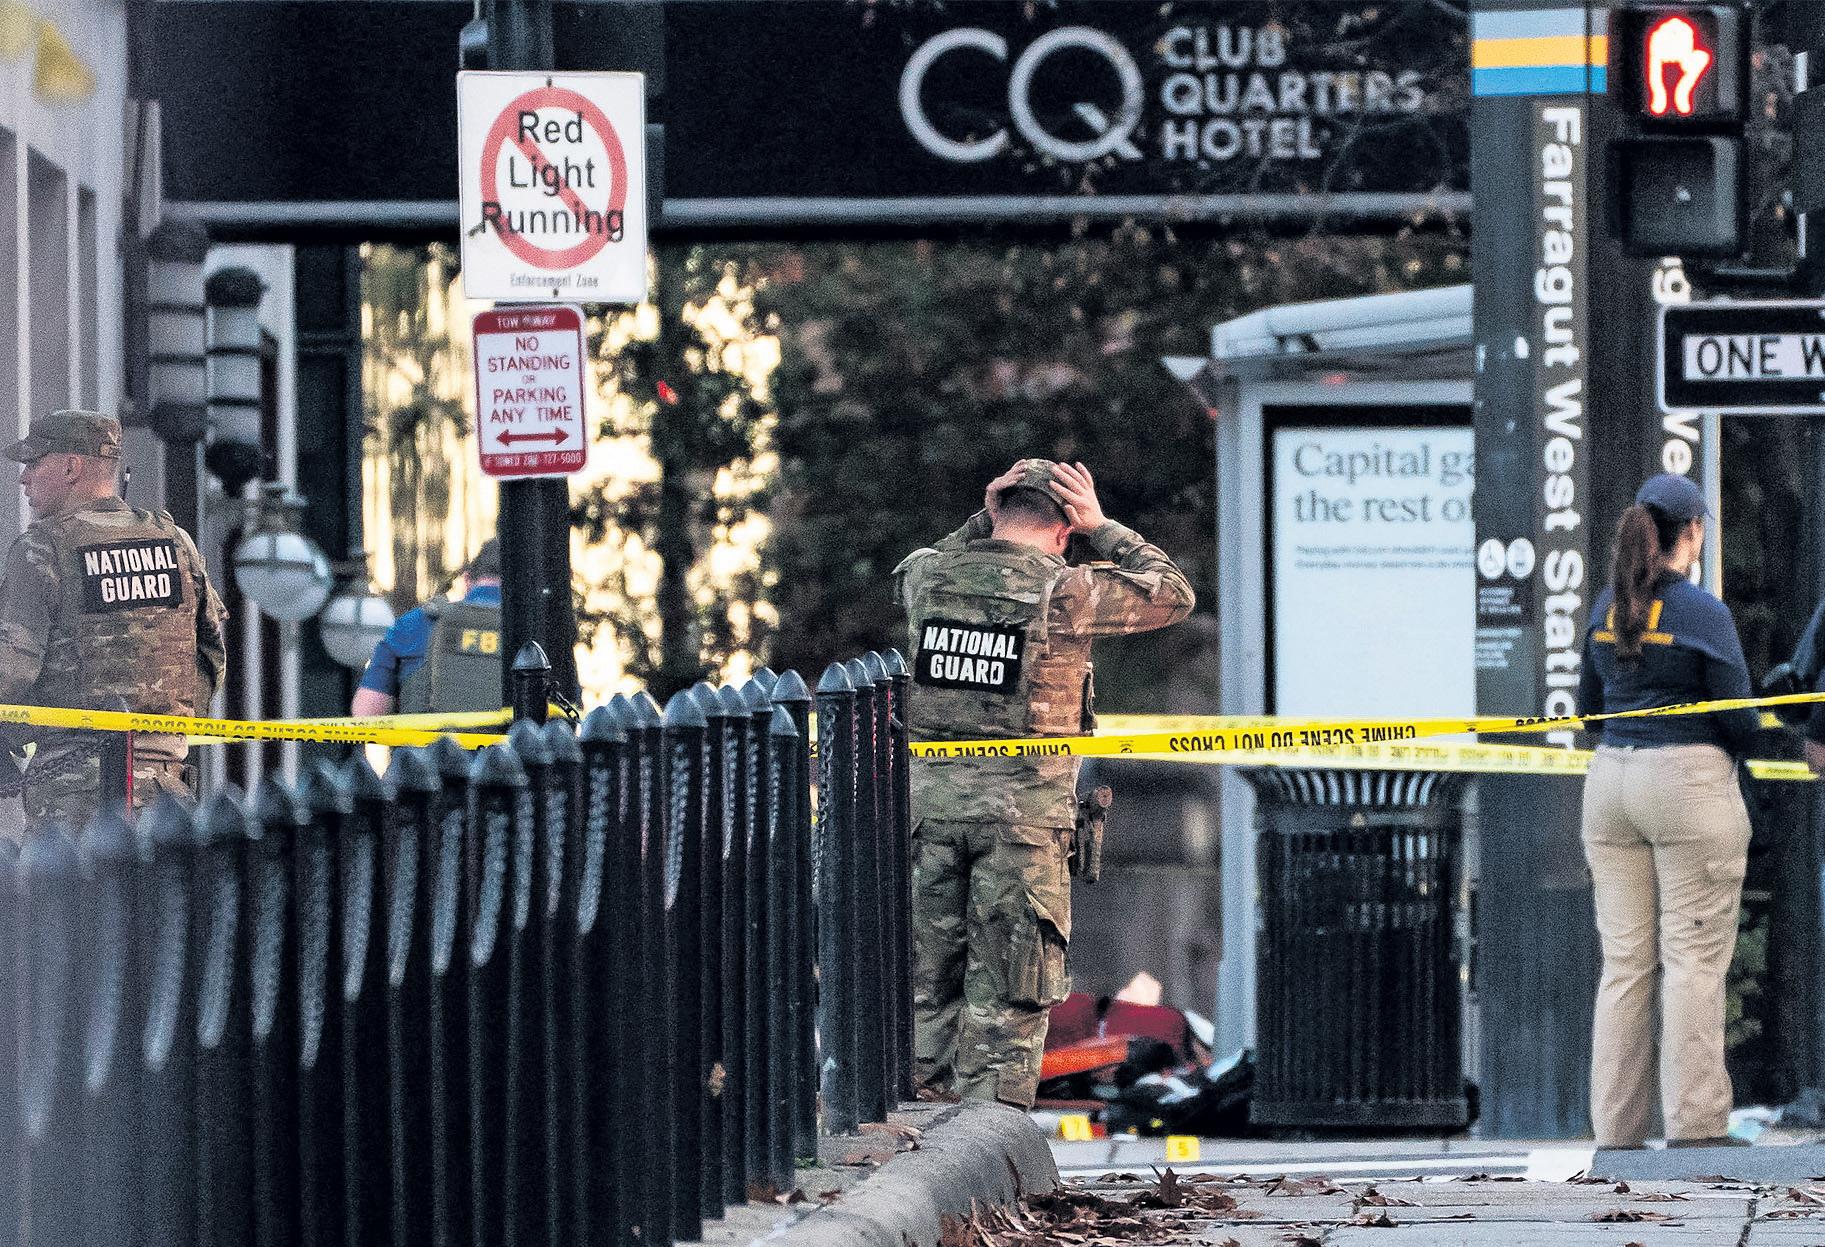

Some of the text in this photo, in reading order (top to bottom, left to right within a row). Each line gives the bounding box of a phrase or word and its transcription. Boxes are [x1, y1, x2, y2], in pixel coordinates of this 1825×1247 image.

[1161, 26, 1286, 67] CLUB
[899, 26, 1144, 162] CQ
[1161, 71, 1425, 113] QUARTERS
[518, 111, 583, 144] Red
[1161, 120, 1322, 159] HOTEL
[509, 155, 596, 197] Light
[482, 201, 625, 243] Running
[1535, 107, 1582, 368] Farragut
[515, 336, 539, 352] NO
[1697, 335, 1825, 375] ONE W
[488, 354, 570, 373] STANDING
[521, 373, 536, 385] OR
[493, 386, 567, 404] PARKING
[489, 406, 573, 424] ANY TIME
[1294, 442, 1431, 485] Capital
[1544, 378, 1583, 532] West
[1293, 489, 1352, 523] the
[1361, 494, 1432, 523] rest
[84, 545, 177, 576] NATIONAL
[100, 573, 171, 603] GUARD
[461, 629, 499, 654] FB
[923, 626, 1018, 660] NATIONAL
[930, 653, 1005, 685] GUARD
